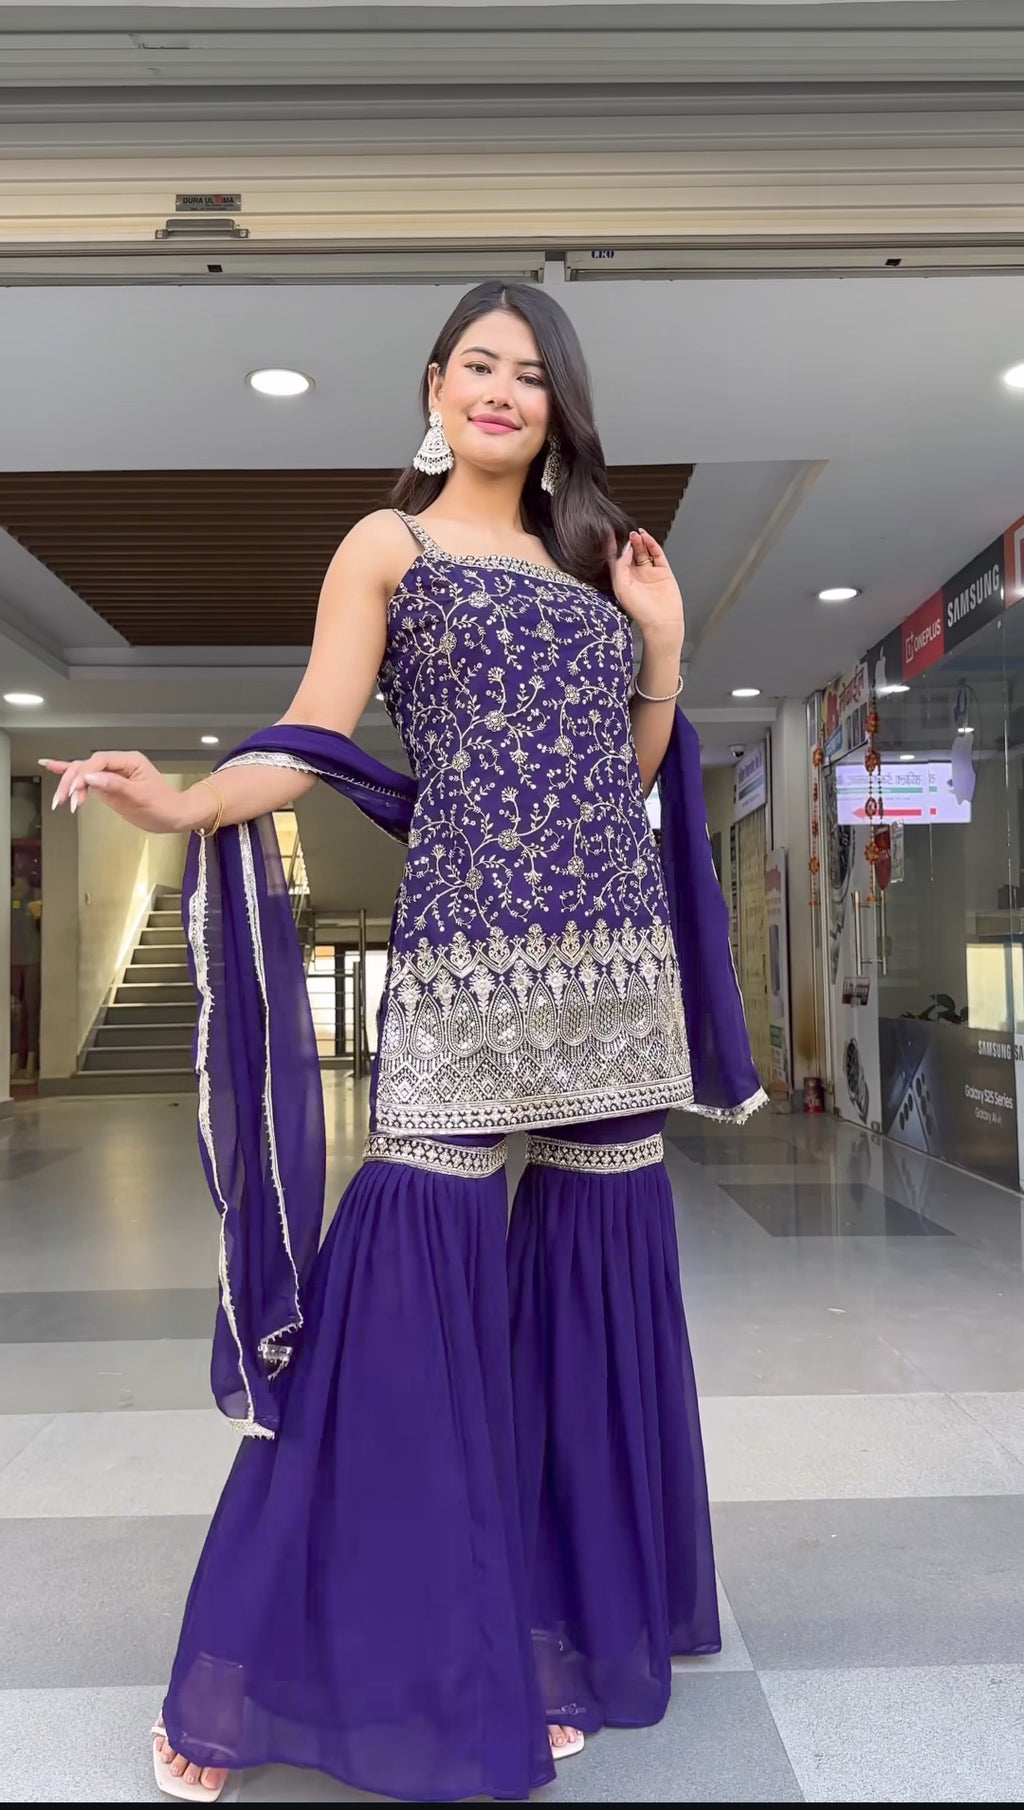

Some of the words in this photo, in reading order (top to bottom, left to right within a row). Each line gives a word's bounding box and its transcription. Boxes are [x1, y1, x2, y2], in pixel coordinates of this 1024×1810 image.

[947, 564, 1000, 628] SAMSUNG
[913, 618, 941, 653] ONEPLUS
[978, 1040, 1011, 1060] SAMSUNG
[965, 1084, 984, 1104] Galaxy
[984, 1089, 994, 1105] S25
[994, 1092, 1013, 1109] Series
[975, 1107, 992, 1124] Galaxy
